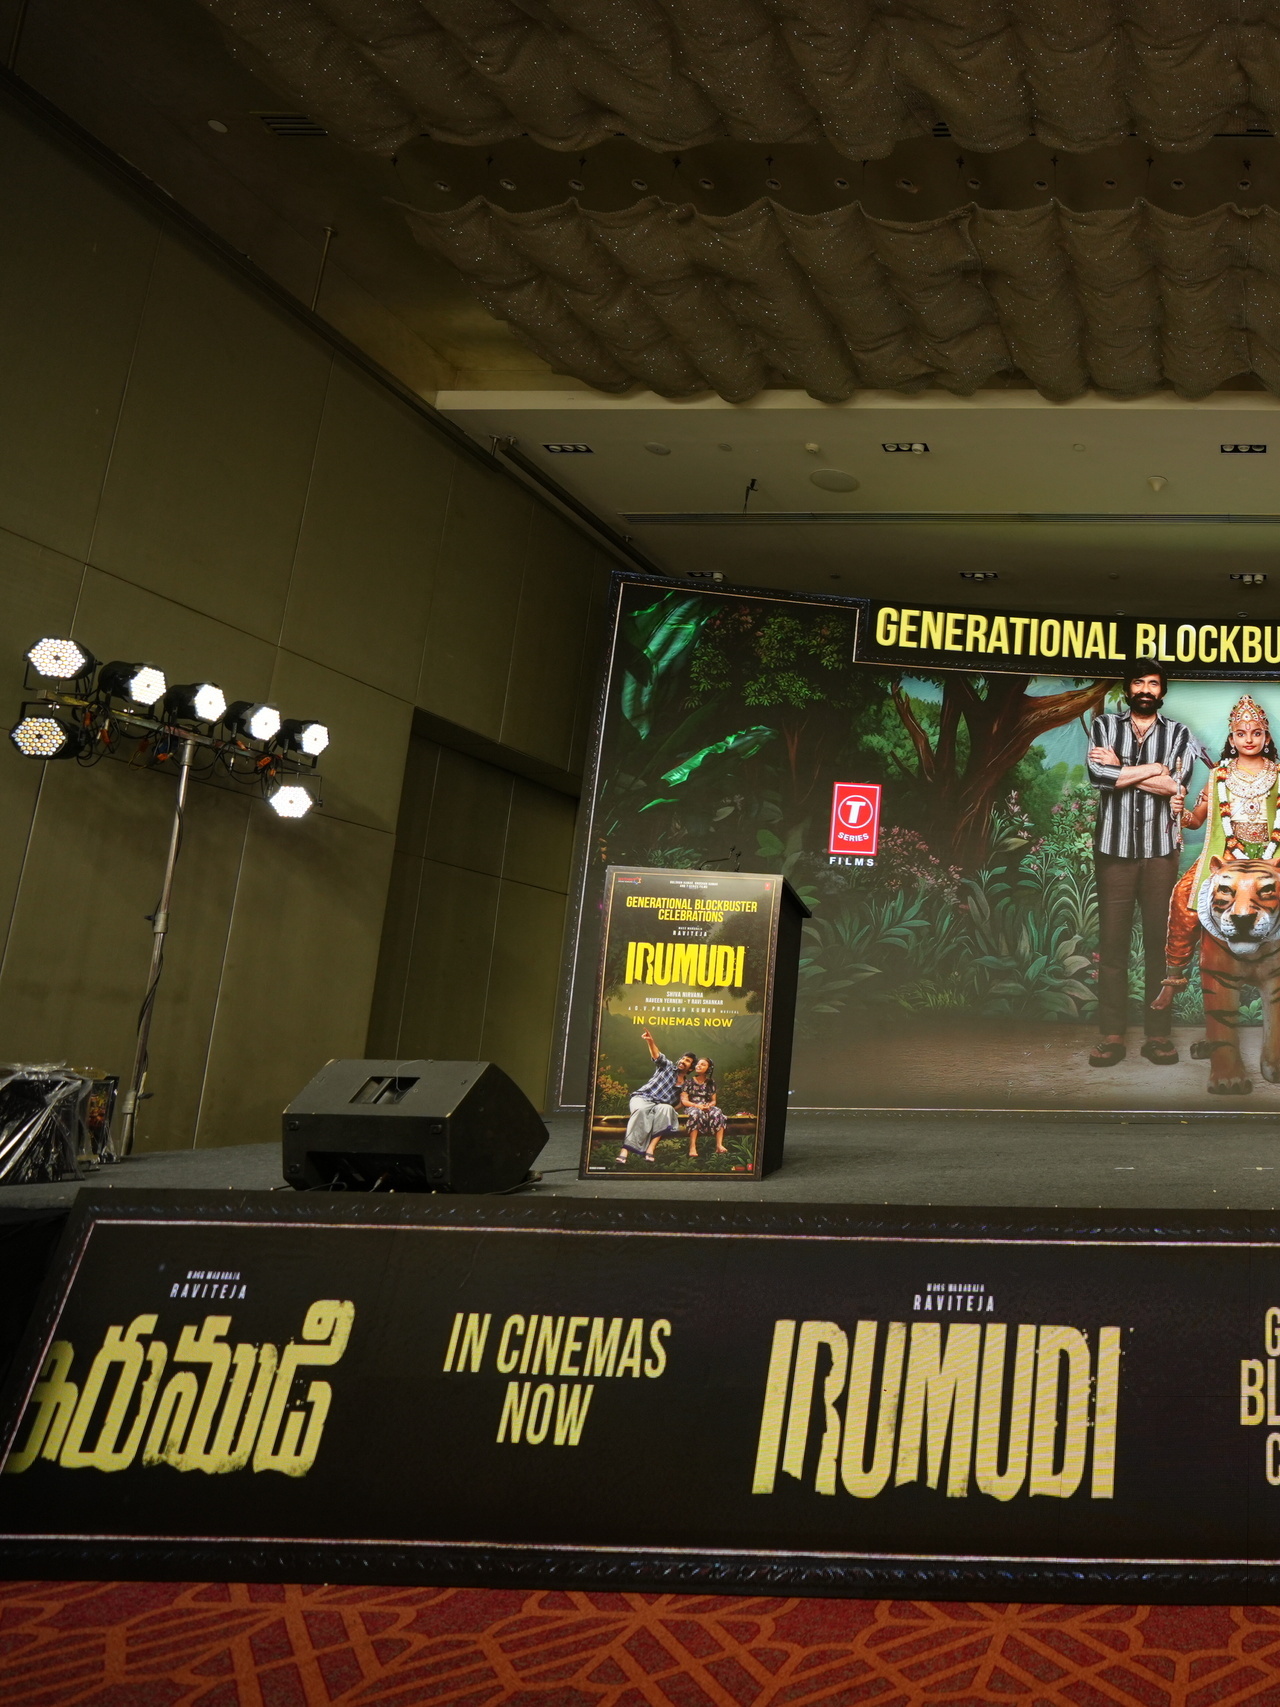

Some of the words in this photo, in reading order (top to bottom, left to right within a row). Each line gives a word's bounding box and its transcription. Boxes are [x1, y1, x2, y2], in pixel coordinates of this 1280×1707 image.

[875, 606, 1126, 661] GENERATIONAL
[845, 801, 866, 824] T
[837, 831, 870, 842] SERIES
[829, 856, 874, 866] FILMS
[626, 896, 692, 910] GENERATIONAL
[695, 899, 758, 912] BLOCKBUSTER
[658, 909, 724, 922] CELEBRATIONS
[624, 942, 746, 988] IRUMUDI
[632, 1016, 645, 1025] IN
[648, 1016, 701, 1027] CINEMAS
[704, 1018, 733, 1027] NOW
[169, 1282, 247, 1299] RAVITEJA
[913, 1294, 995, 1312] RAVITEJA
[443, 1312, 492, 1373] IN
[496, 1313, 672, 1379] CINEMAS
[496, 1381, 595, 1446] NOW
[752, 1319, 1122, 1502] IRUMUDI
